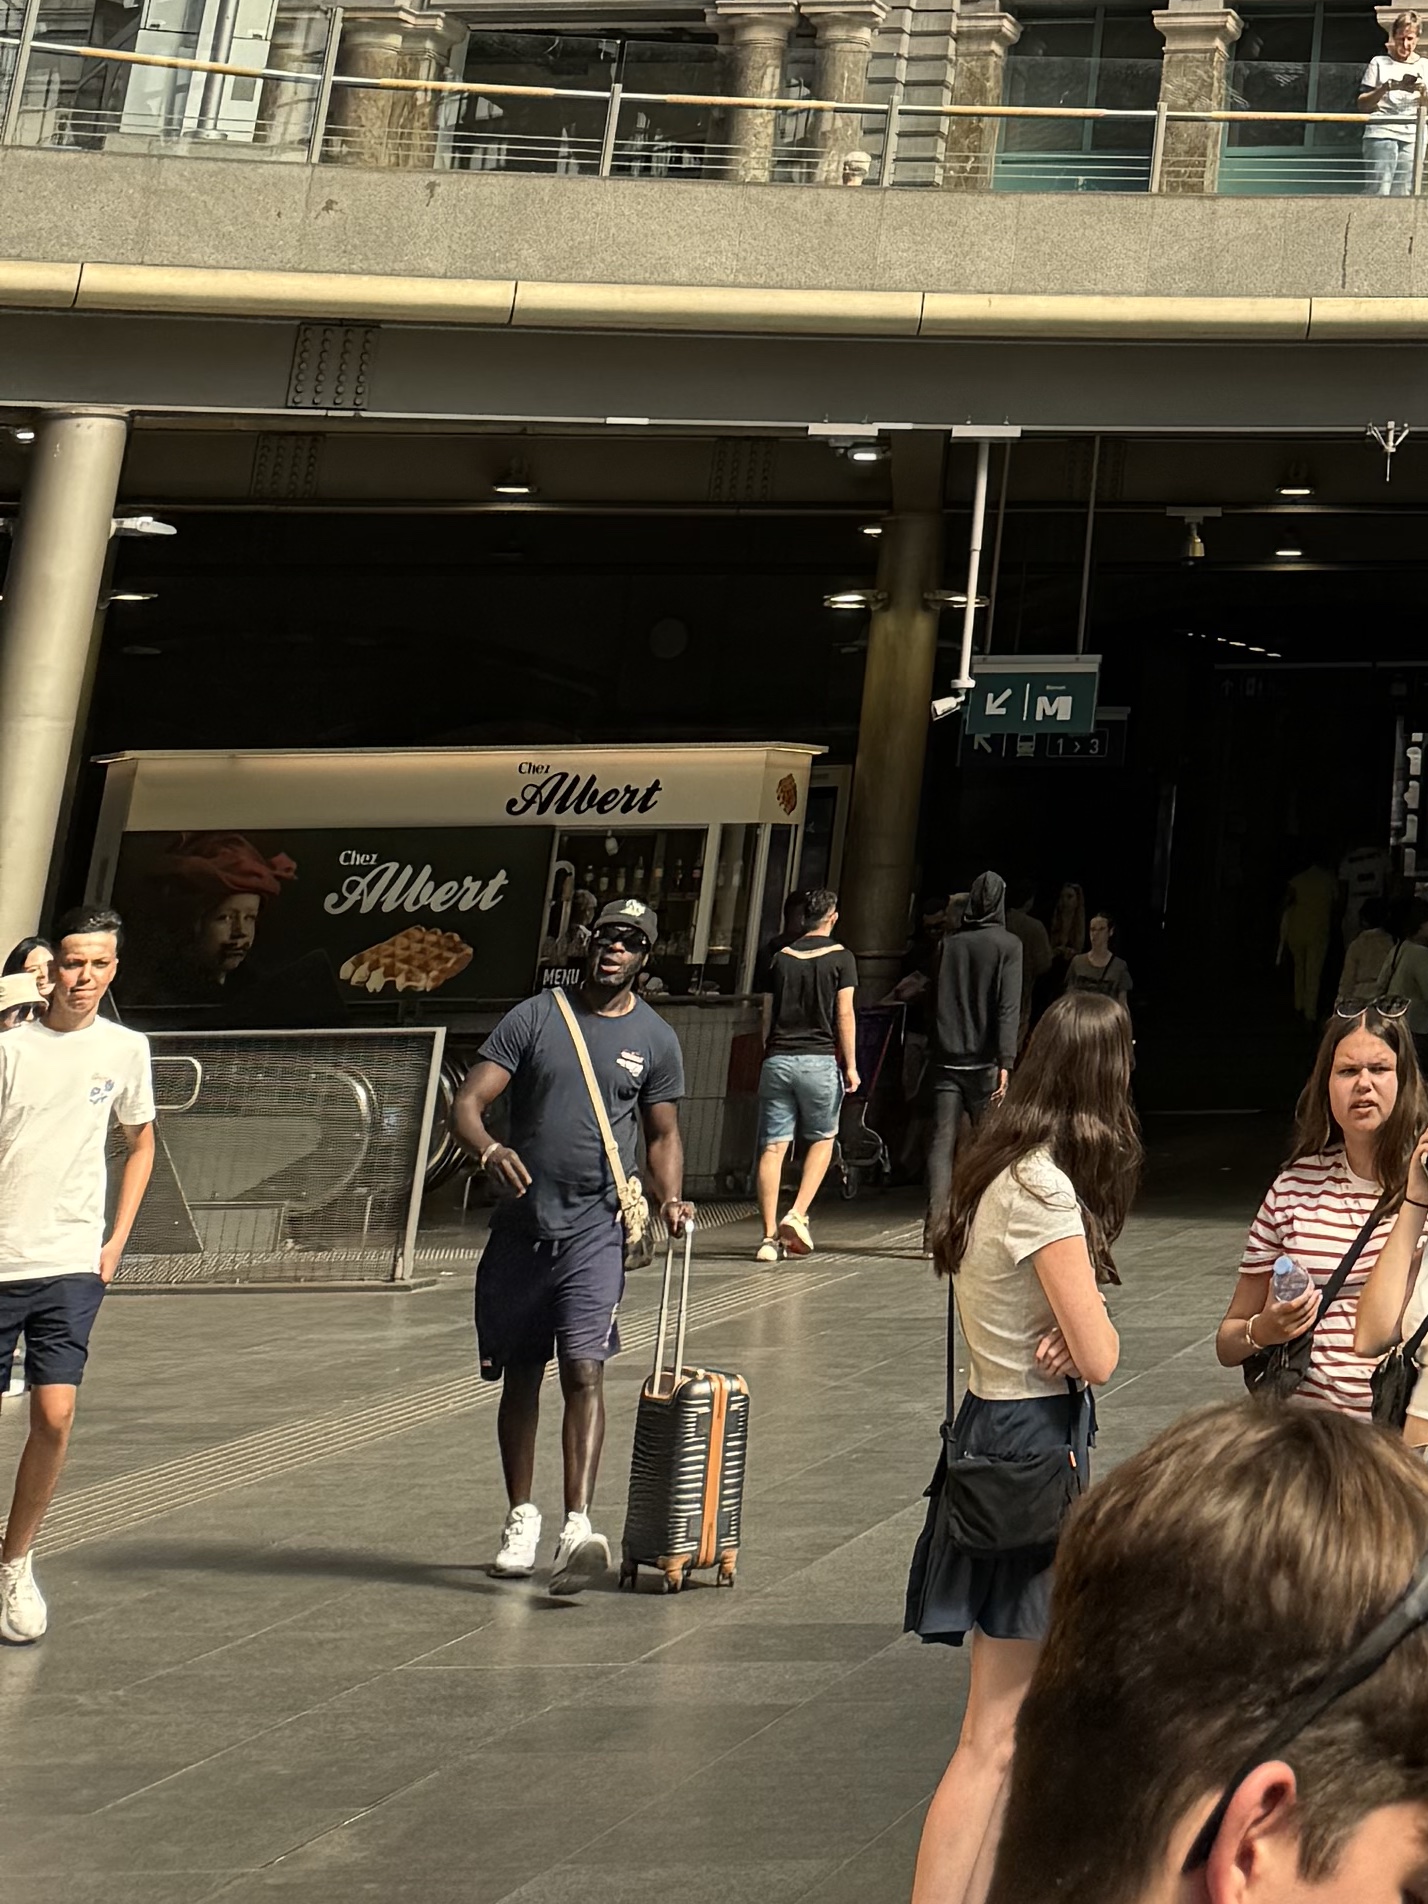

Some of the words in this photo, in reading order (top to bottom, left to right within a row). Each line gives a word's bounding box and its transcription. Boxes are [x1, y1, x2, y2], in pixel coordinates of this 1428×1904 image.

[1056, 737, 1065, 756] 1
[1089, 738, 1100, 755] 3
[518, 761, 551, 775] Chez
[505, 771, 663, 817] Albert
[338, 849, 379, 867] Chez
[323, 861, 509, 915] Albert
[542, 967, 581, 986] MENU
